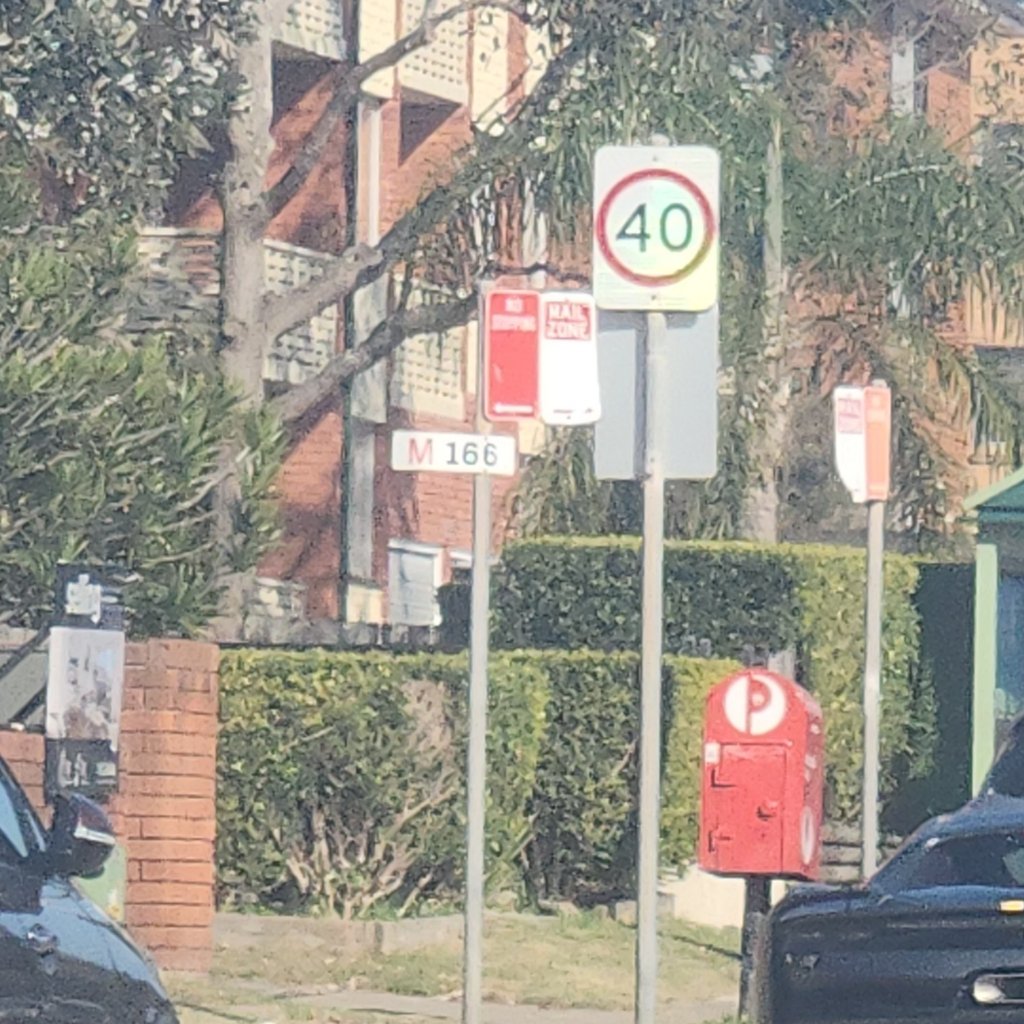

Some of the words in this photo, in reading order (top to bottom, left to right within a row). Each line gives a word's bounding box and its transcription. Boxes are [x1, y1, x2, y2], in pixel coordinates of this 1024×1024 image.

[615, 202, 693, 252] 40
[548, 303, 588, 320] MAIL
[547, 321, 589, 339] ZONE
[408, 438, 433, 465] M
[446, 441, 498, 466] 166
